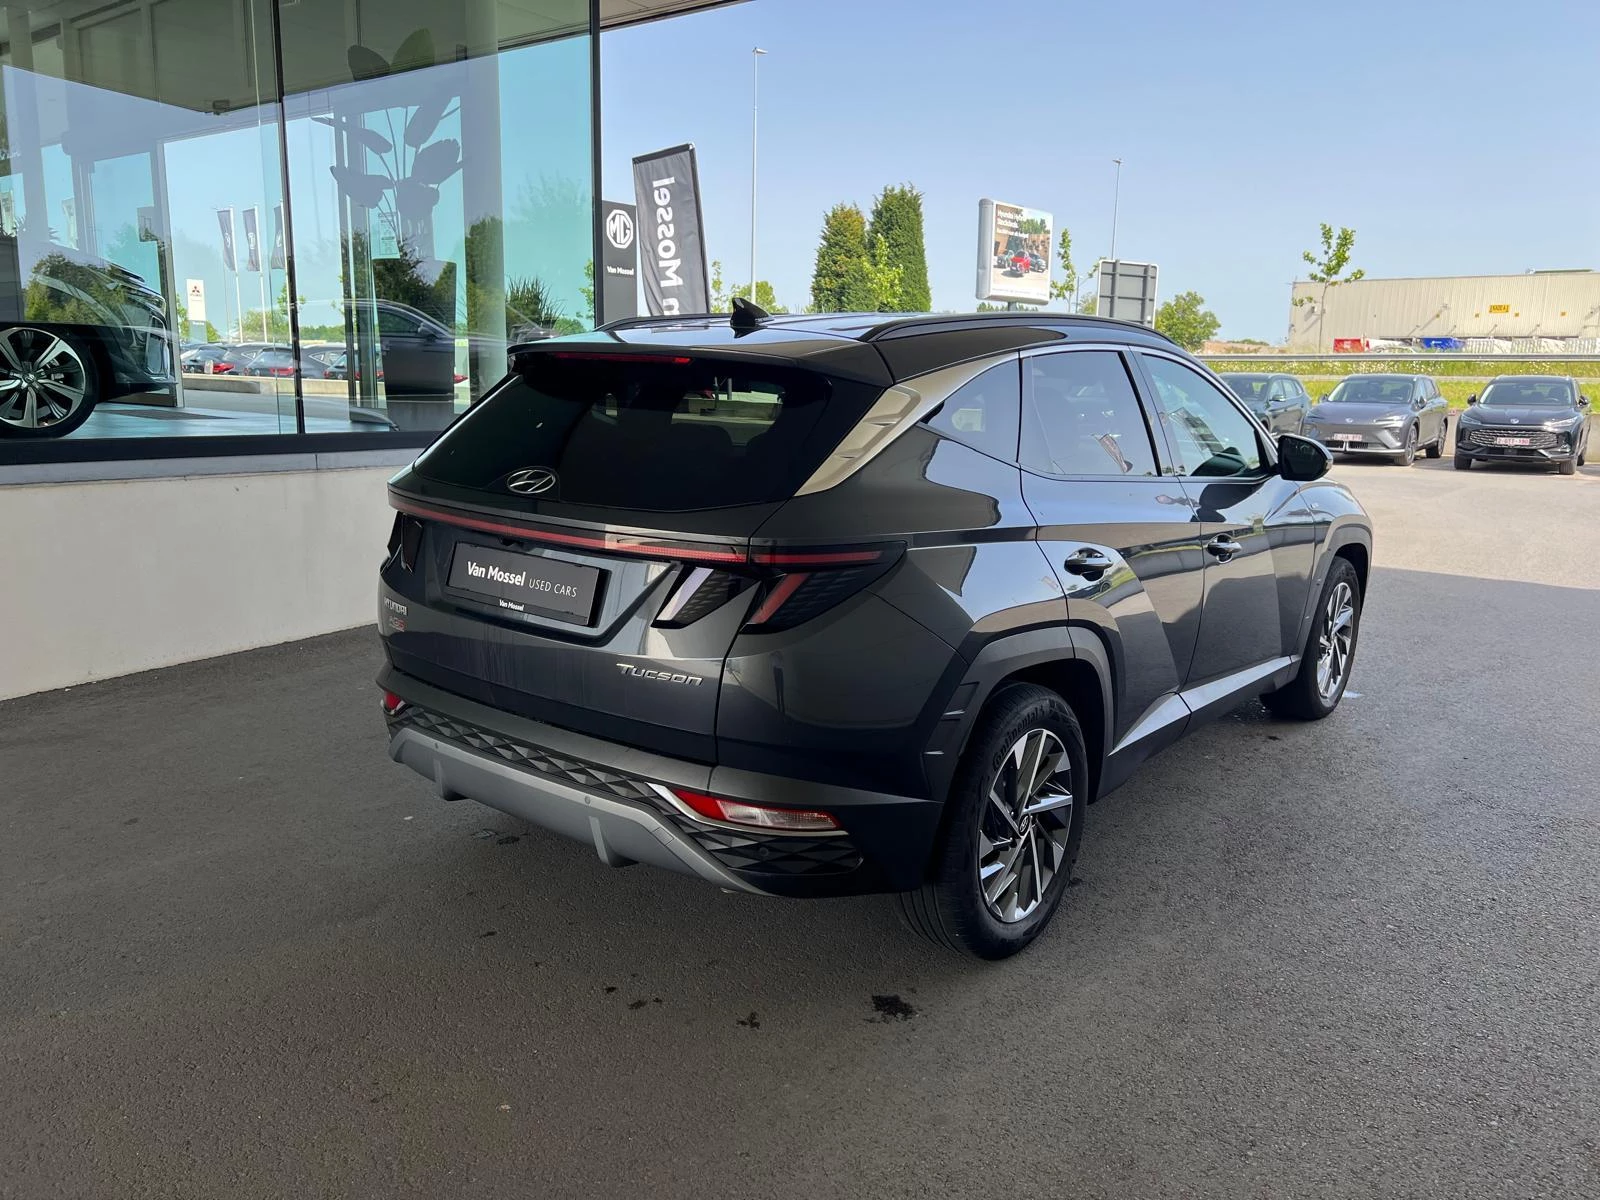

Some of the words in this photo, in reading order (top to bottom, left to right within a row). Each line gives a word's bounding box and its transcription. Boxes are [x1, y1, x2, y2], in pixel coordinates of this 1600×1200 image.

[608, 211, 632, 247] MG
[467, 561, 485, 579] Van
[487, 565, 526, 587] Mossel
[529, 578, 551, 592] USED
[554, 583, 577, 598] CARS
[508, 601, 524, 611] Mossel
